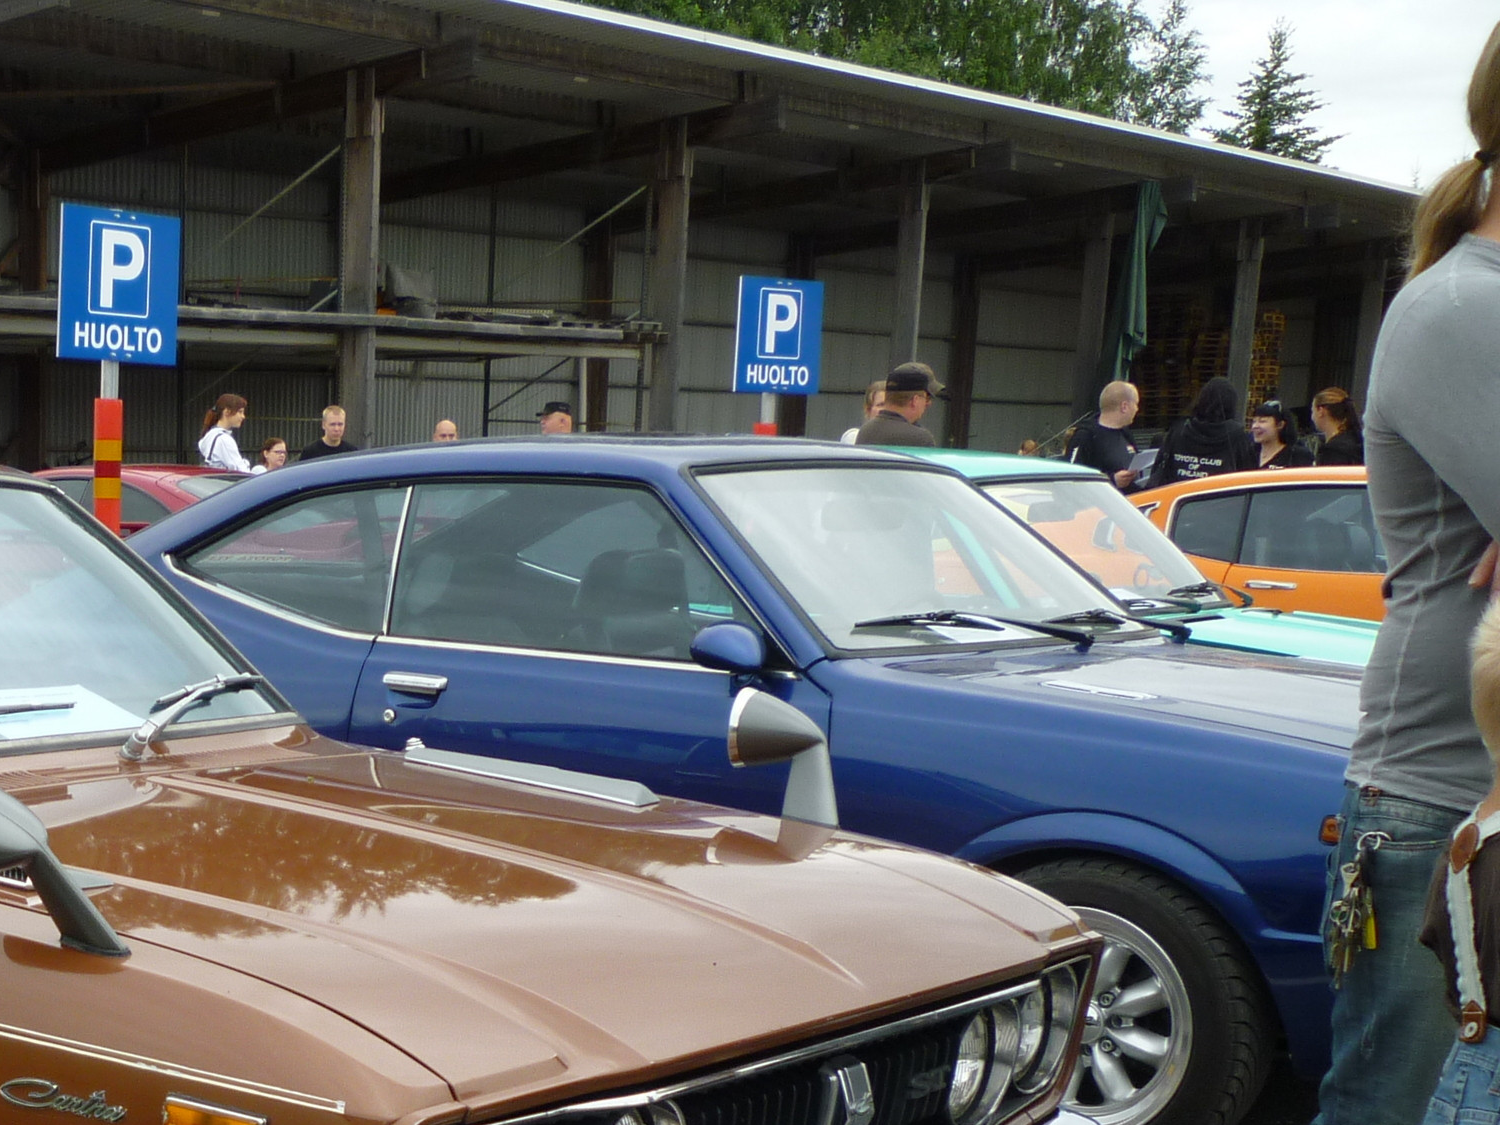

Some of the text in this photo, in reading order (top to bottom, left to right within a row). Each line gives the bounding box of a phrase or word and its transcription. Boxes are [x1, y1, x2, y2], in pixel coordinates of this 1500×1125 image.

[100, 228, 145, 308] P
[74, 320, 162, 353] HUOLTO
[765, 293, 798, 353] P
[746, 364, 809, 386] HUOLTO
[1174, 453, 1222, 467] TOYOTA CLUB
